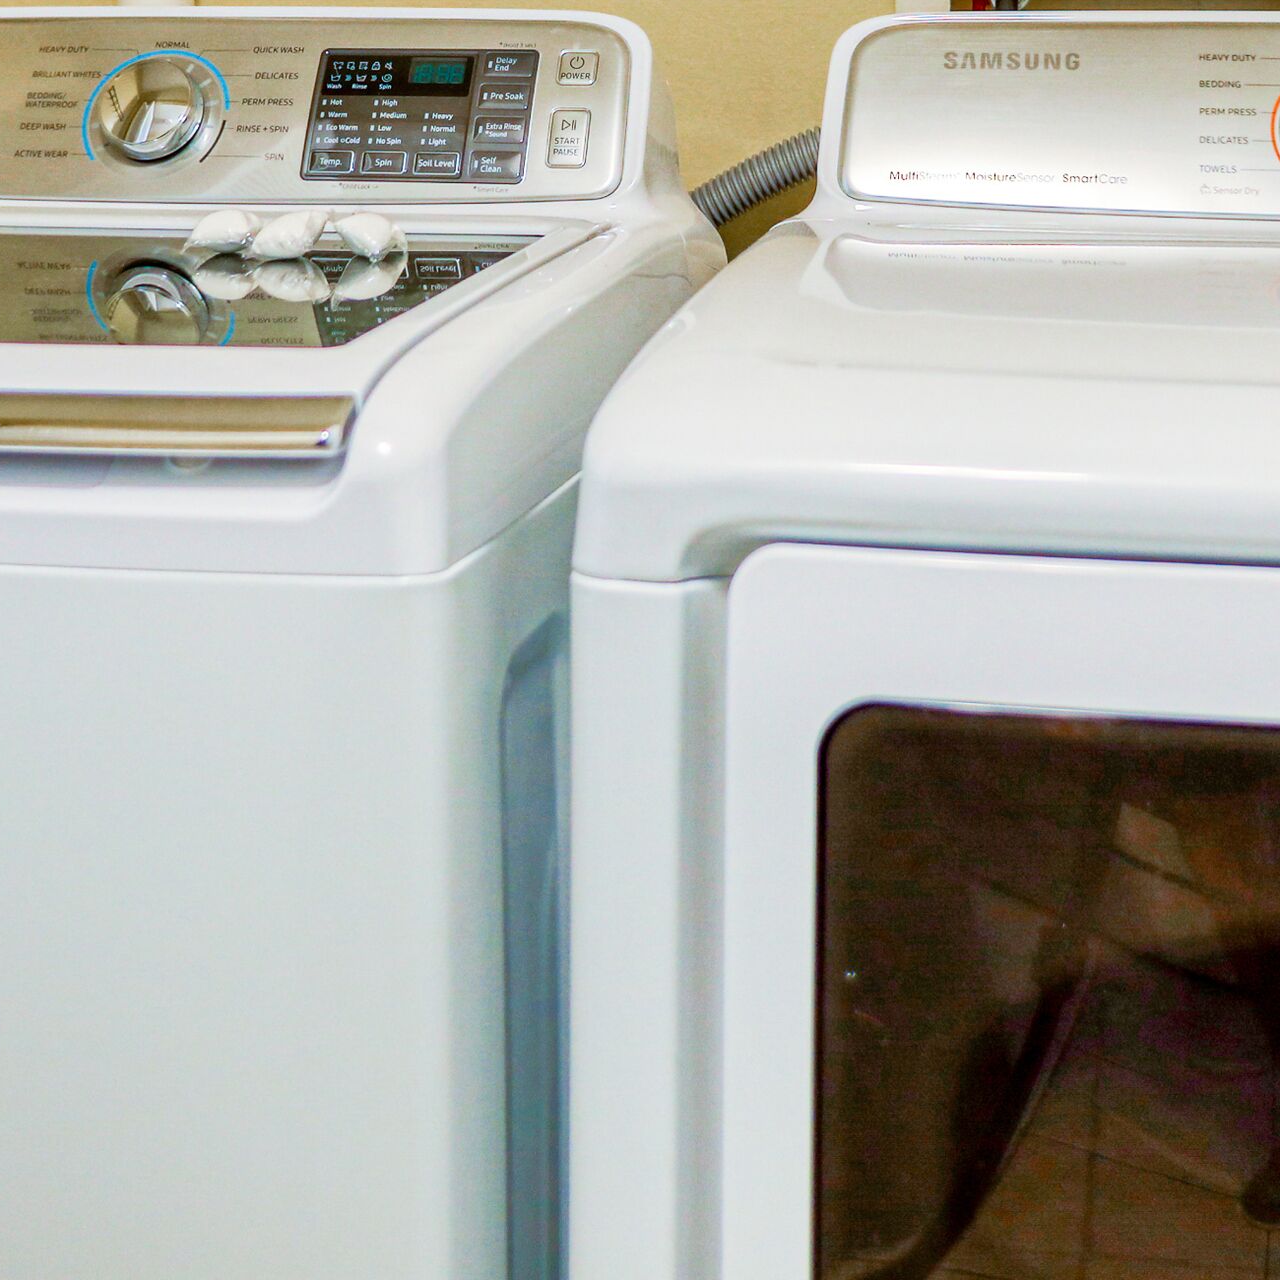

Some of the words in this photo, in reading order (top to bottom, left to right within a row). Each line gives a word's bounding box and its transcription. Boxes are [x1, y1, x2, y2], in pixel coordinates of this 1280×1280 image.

[39, 45, 65, 53] HEAVY
[67, 45, 89, 53] DUTY
[155, 41, 190, 49] NORMAL
[253, 46, 279, 54] QUICK
[280, 46, 305, 54] WASH
[496, 57, 517, 65] Delay
[943, 51, 1080, 70] SAMSUNG
[1199, 54, 1229, 62] HEAVY
[1231, 54, 1257, 62] DUTY
[255, 72, 299, 80] DELICATES
[560, 72, 591, 80] POWER
[1199, 80, 1242, 88] BEDDING
[490, 92, 504, 100] Pre
[505, 92, 524, 100] Soak
[242, 98, 266, 106] PERM
[267, 98, 294, 106] PRESS
[382, 99, 398, 107] High
[379, 111, 407, 119] Medium
[1199, 108, 1225, 116] PERM
[1228, 108, 1257, 116] PRESS
[432, 112, 453, 121] Heavy
[43, 123, 67, 131] WASH
[236, 125, 261, 133] RINSE
[269, 125, 289, 133] SPIN
[430, 125, 455, 133] Normal
[503, 123, 522, 131] Rinse
[386, 137, 402, 146] Spin
[428, 138, 446, 146] Light
[555, 137, 580, 145] START
[1199, 136, 1249, 144] DELICATES
[553, 148, 579, 156] PAUSE
[264, 153, 285, 161] SPIN
[320, 157, 342, 166] Temp.
[375, 158, 392, 167] Spin
[418, 158, 432, 167] Soil
[434, 158, 455, 167] Level
[480, 165, 502, 173] Clean
[1200, 164, 1237, 173] TOWELS
[1062, 173, 1128, 184] SmartCare
[1213, 186, 1242, 194] Sensor
